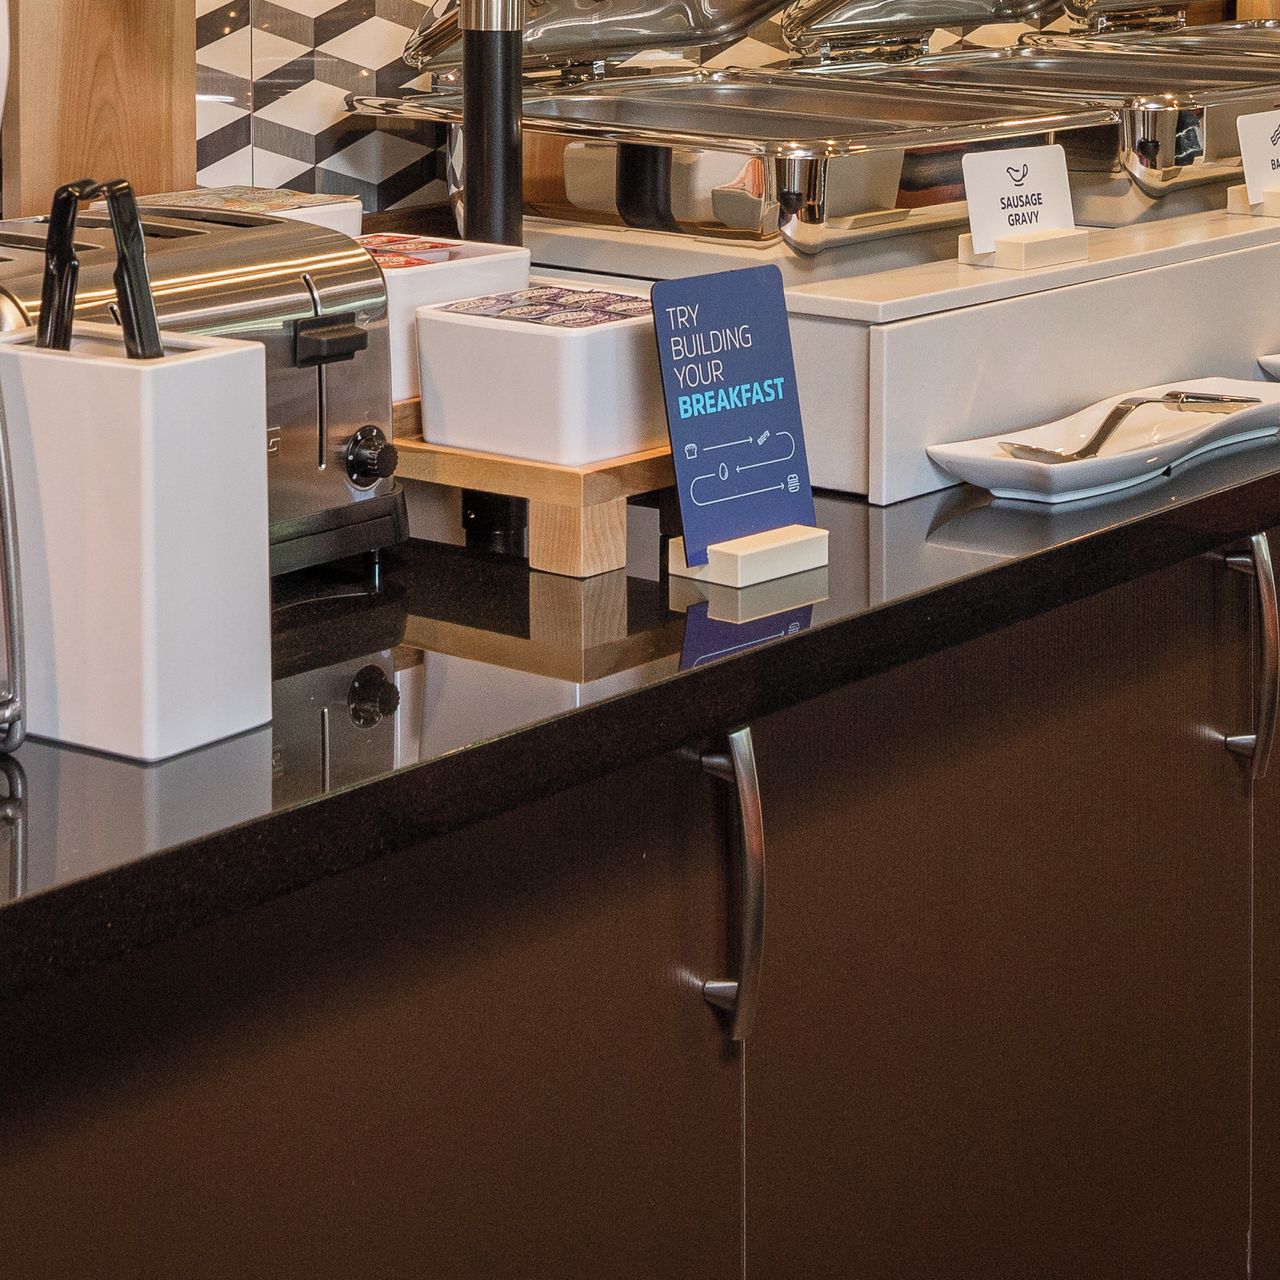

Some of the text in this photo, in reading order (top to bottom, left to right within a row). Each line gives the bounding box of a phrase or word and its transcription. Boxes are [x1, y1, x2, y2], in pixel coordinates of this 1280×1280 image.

[999, 192, 1044, 211] SAUSAGE
[1007, 210, 1040, 227] GRAVY
[665, 303, 700, 331] TRY
[669, 324, 753, 361] BUILDING
[673, 359, 725, 390] YOUR
[677, 376, 786, 420] BREAKFAST
